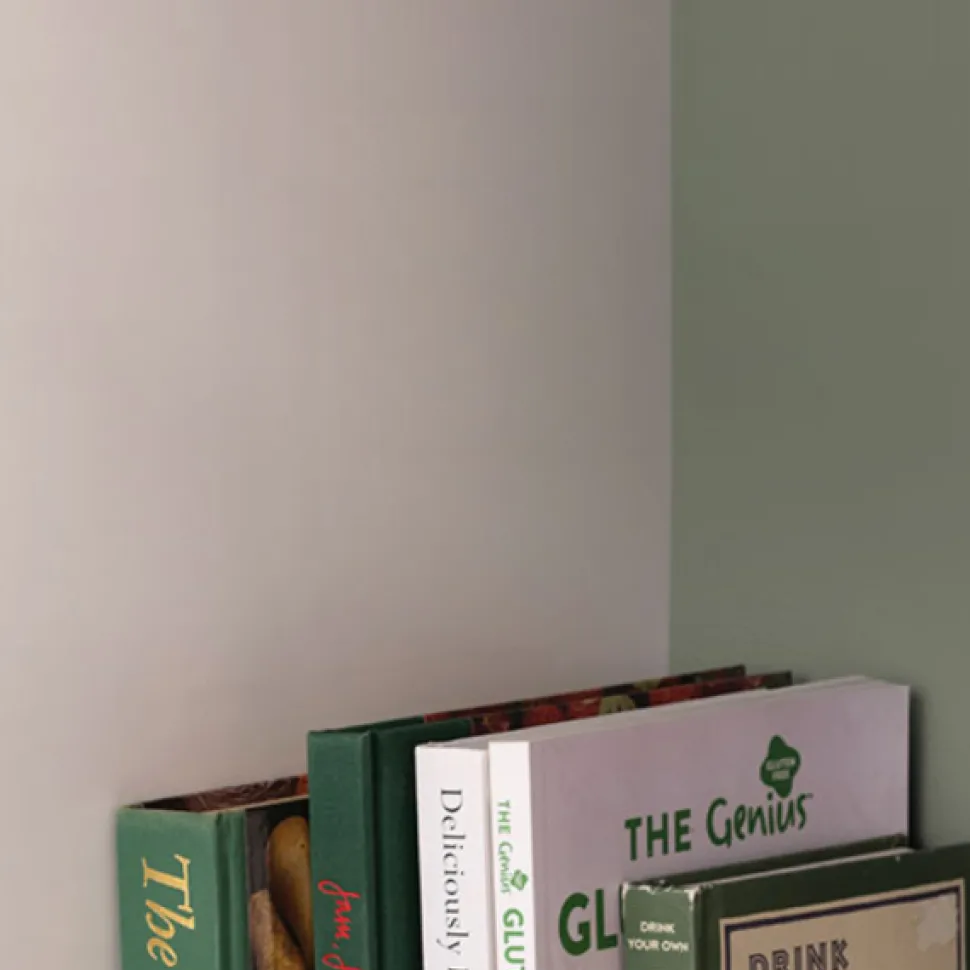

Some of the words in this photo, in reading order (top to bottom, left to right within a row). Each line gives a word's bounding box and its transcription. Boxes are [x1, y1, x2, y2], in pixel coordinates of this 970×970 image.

[496, 799, 512, 835] THE
[623, 808, 692, 861] THE
[706, 791, 808, 848] Genius
[436, 788, 470, 956] Deliciously
[141, 853, 195, 968] The
[558, 888, 618, 957] GL
[640, 920, 676, 935] DRINK
[627, 938, 660, 953] YOUR
[661, 940, 691, 953] OWN
